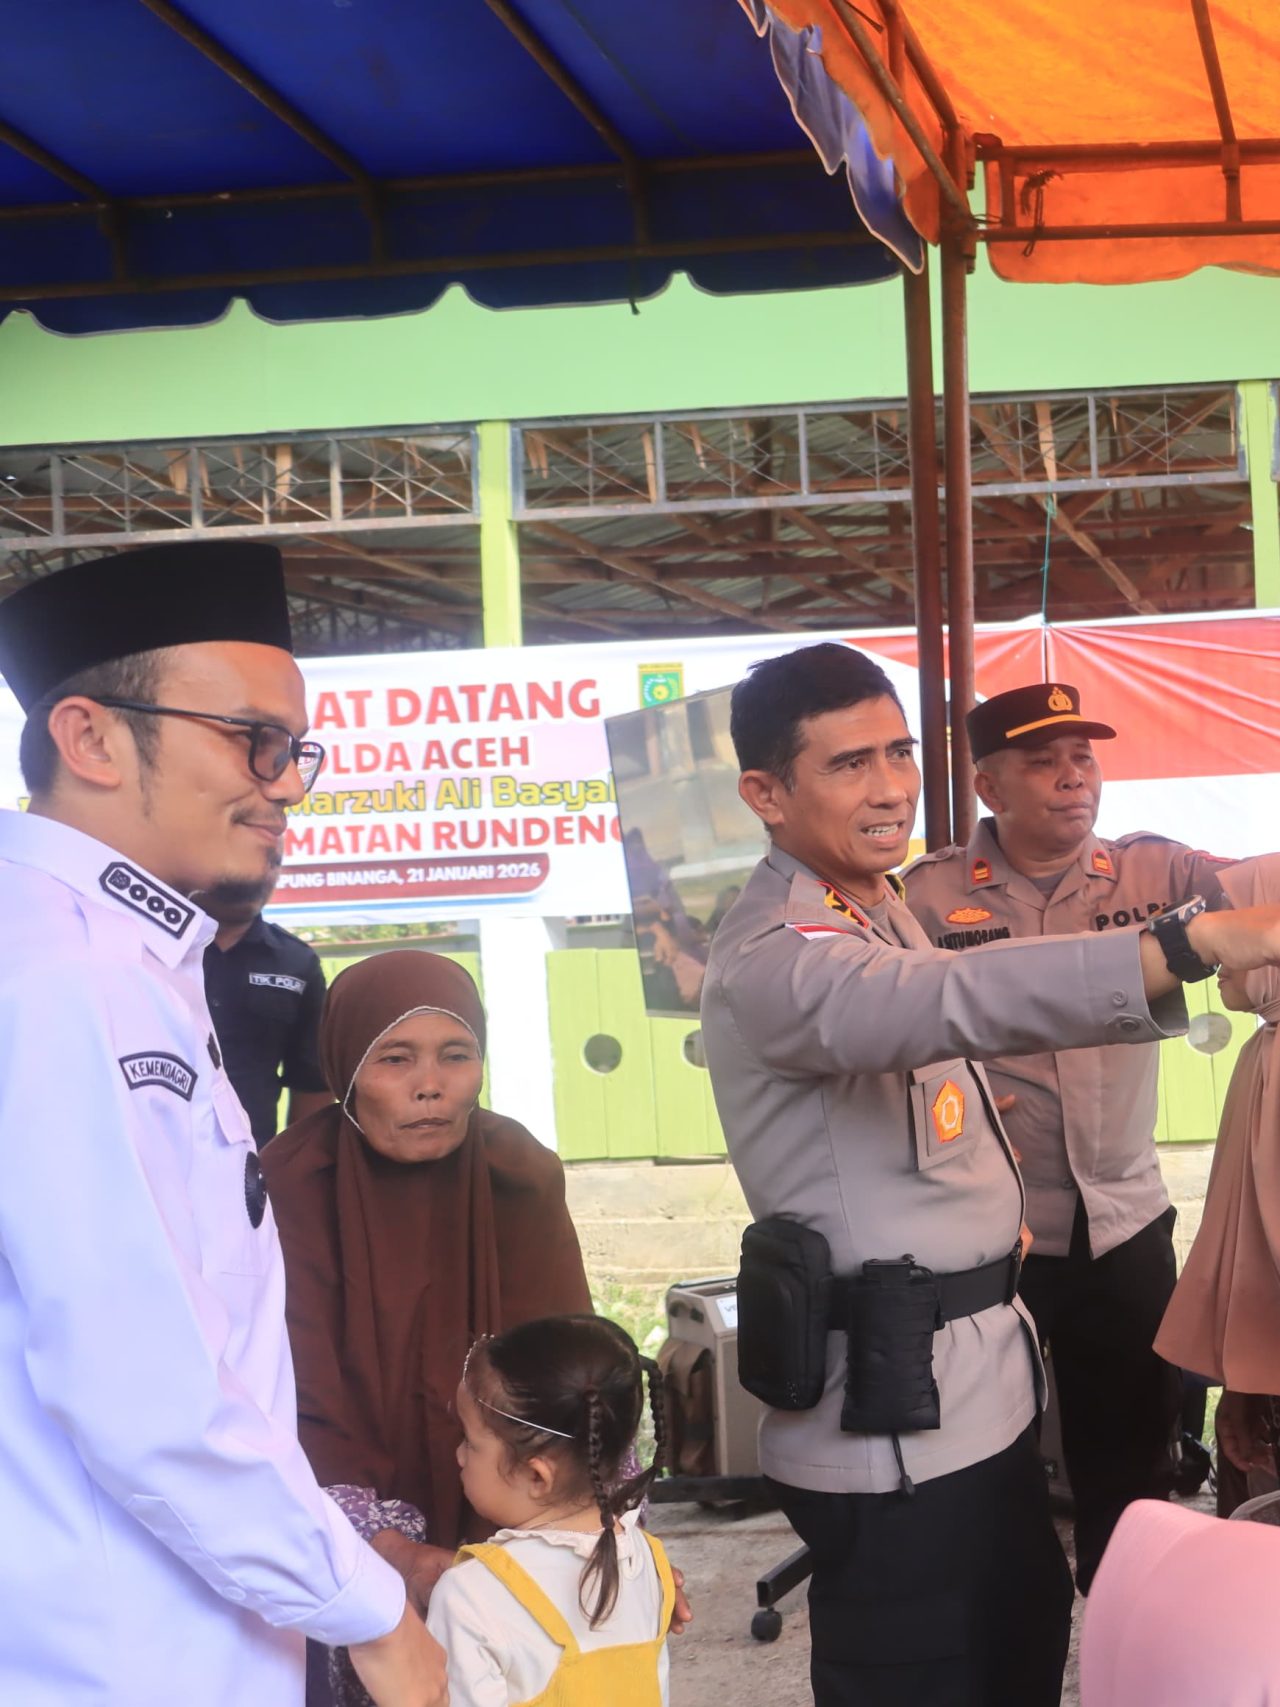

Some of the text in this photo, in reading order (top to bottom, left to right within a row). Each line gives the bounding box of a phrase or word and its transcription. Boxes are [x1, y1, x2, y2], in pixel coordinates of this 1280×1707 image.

[386, 678, 600, 727] DATANG
[421, 735, 529, 771] ACEH
[434, 776, 482, 810] Ali
[275, 862, 542, 889] PUNG BINANGA, 21 JANUARI 2026
[128, 1060, 190, 1091] KEMENDAGRI
